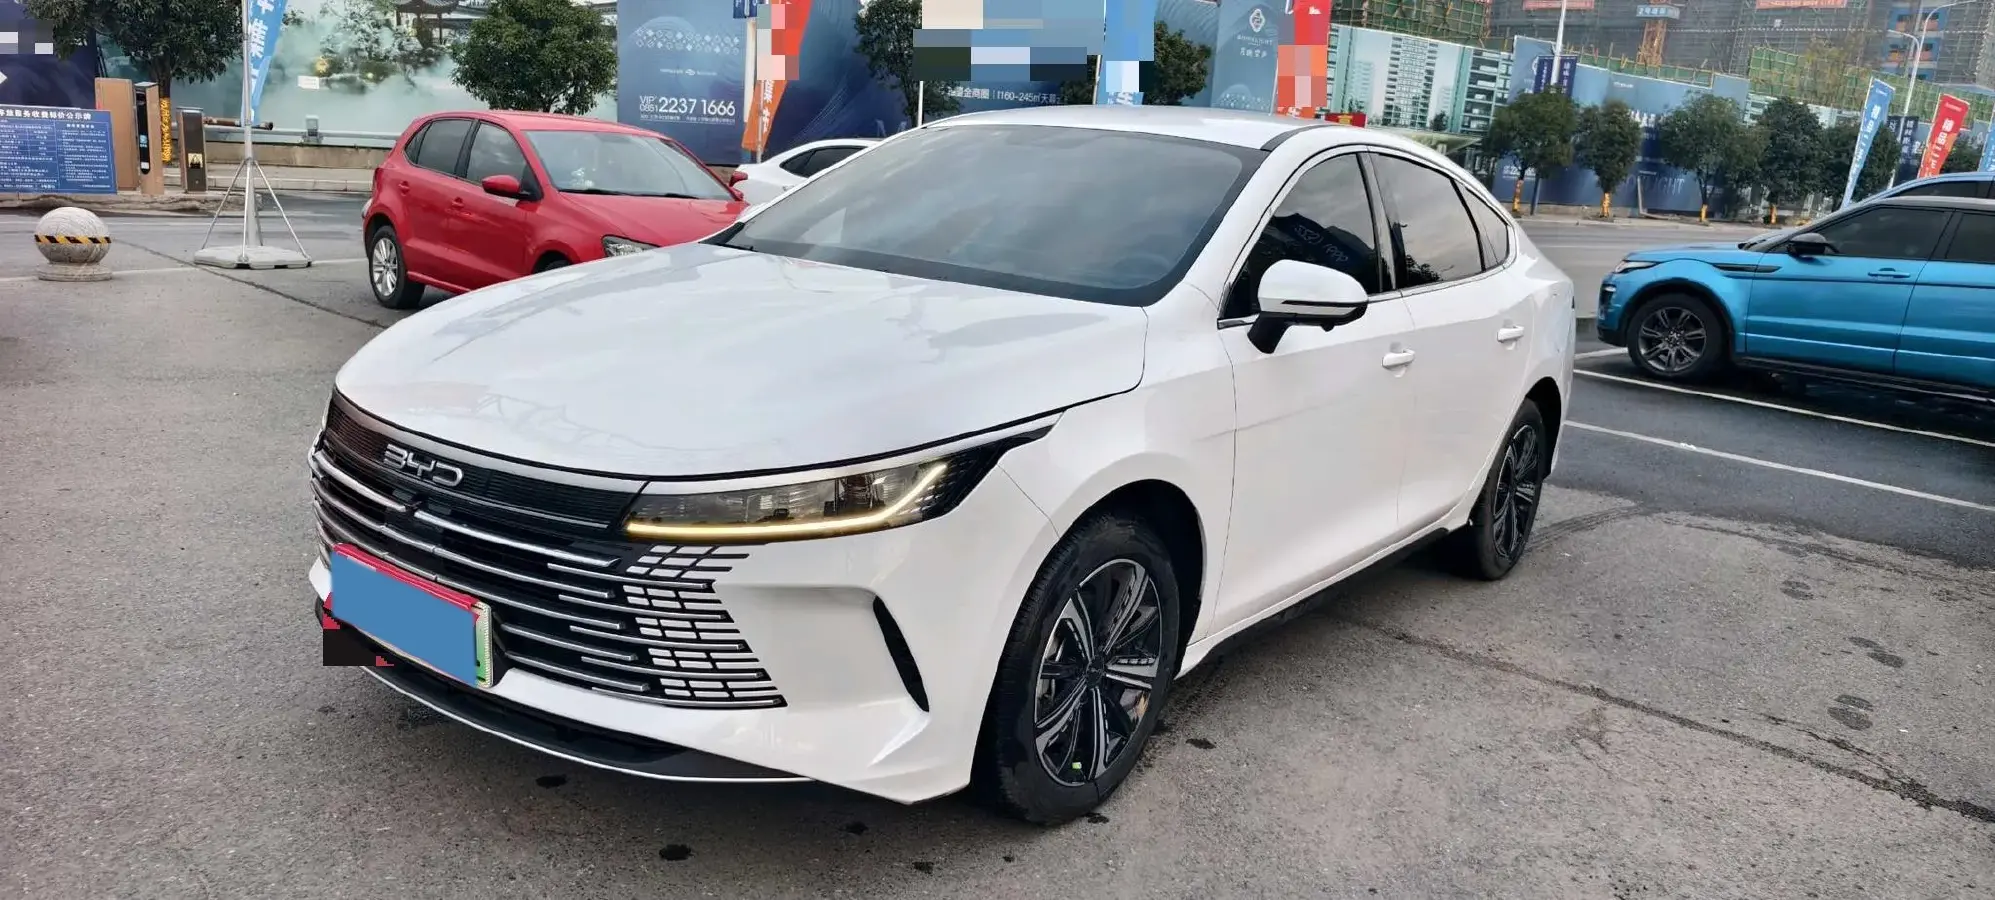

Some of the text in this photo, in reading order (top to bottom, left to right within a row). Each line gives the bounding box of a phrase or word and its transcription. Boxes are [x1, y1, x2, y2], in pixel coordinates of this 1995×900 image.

[659, 96, 697, 114] 2237
[701, 99, 736, 117] 1666
[383, 443, 464, 487] BYD
